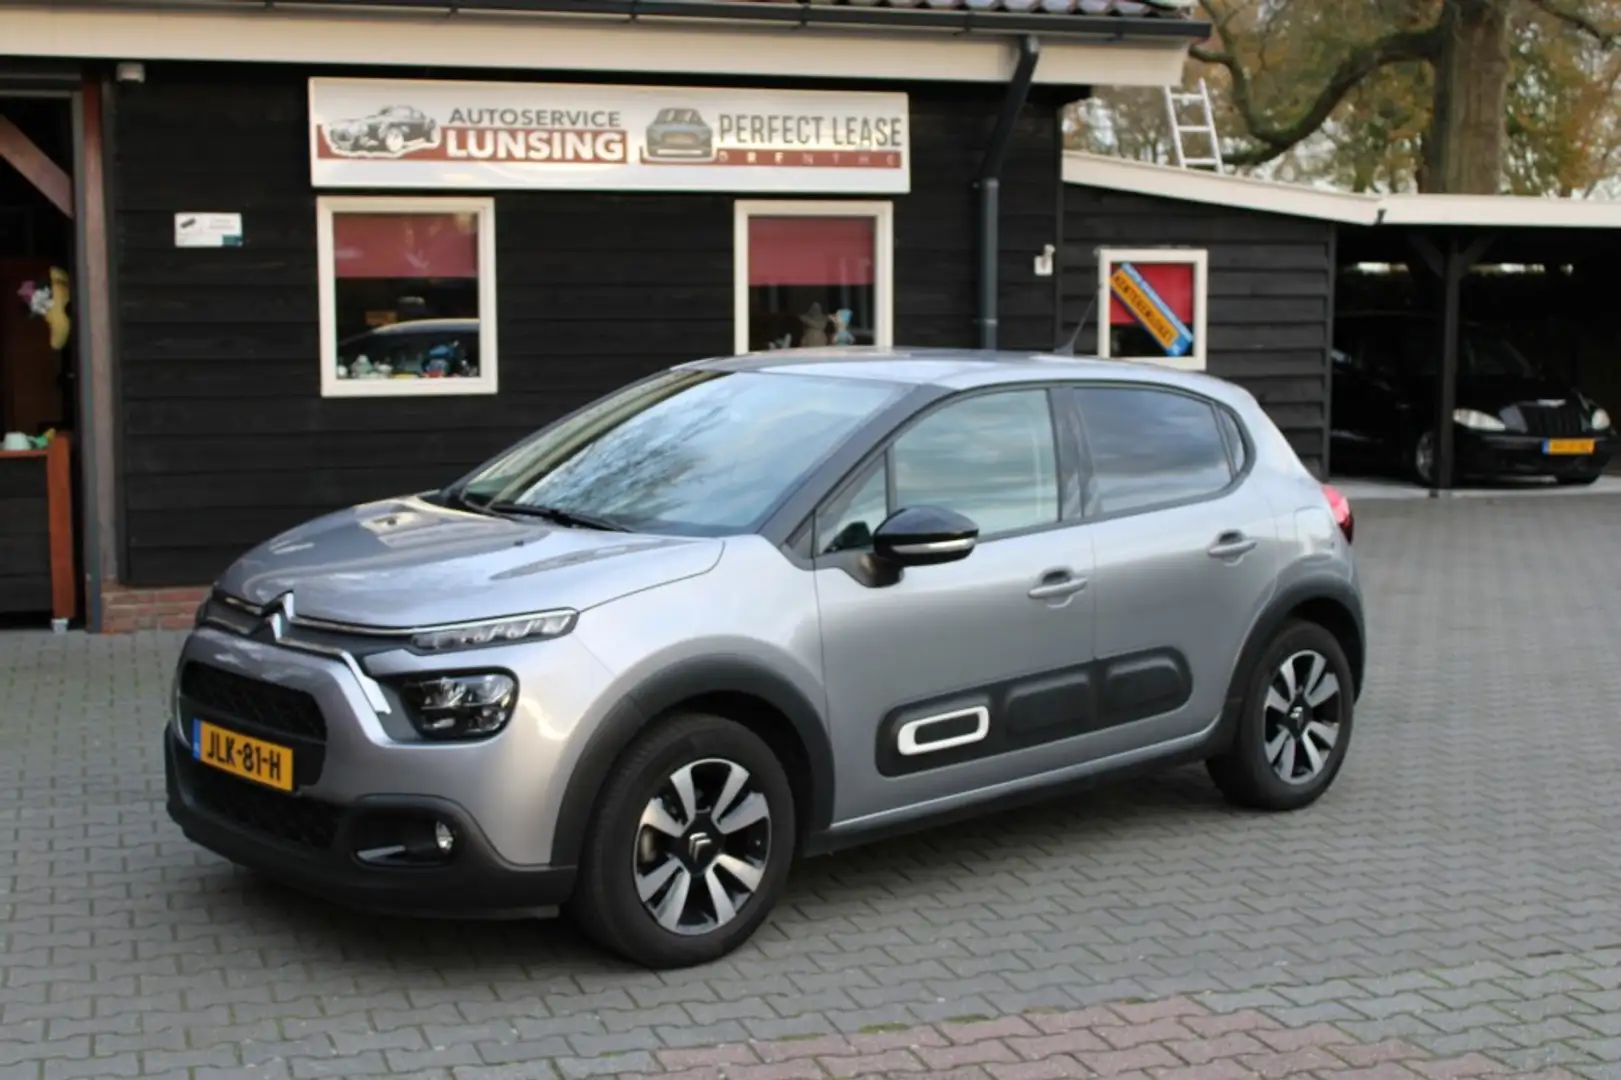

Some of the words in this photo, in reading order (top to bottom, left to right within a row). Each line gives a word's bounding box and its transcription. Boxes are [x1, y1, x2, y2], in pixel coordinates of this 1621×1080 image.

[449, 108, 621, 128] AUTOSERVICE
[718, 114, 824, 144] PERFECT
[832, 116, 902, 147] LEASE
[446, 129, 624, 161] LUNSING
[207, 731, 281, 782] JLK-81-H
